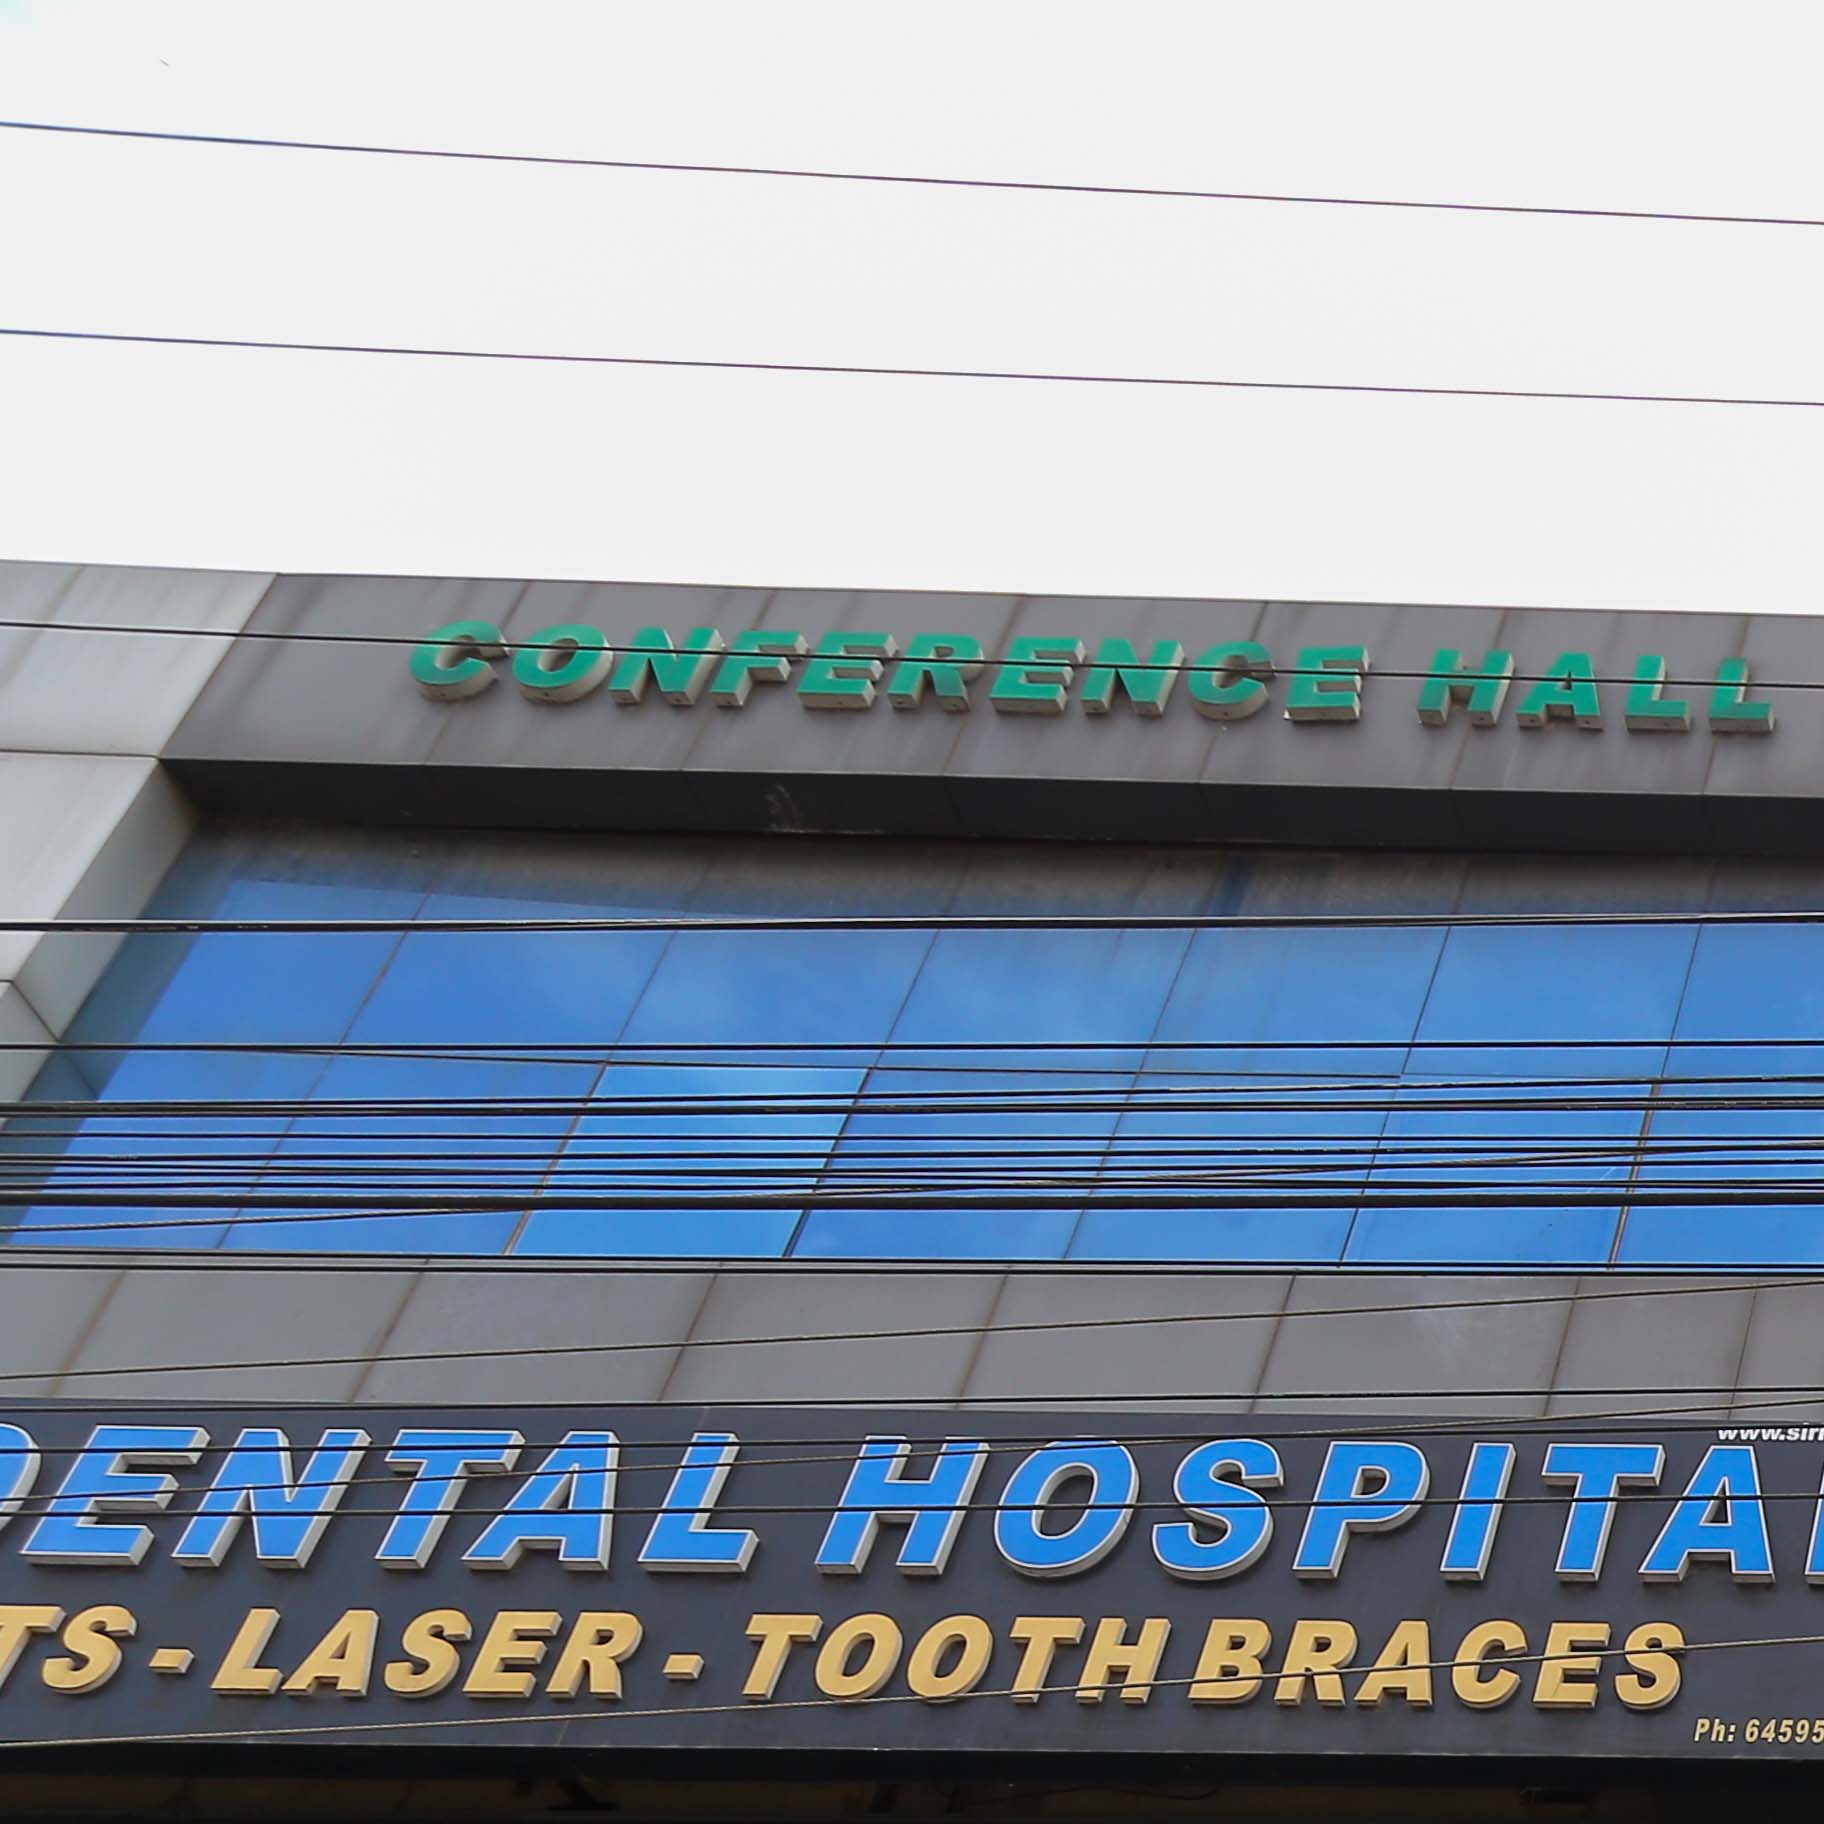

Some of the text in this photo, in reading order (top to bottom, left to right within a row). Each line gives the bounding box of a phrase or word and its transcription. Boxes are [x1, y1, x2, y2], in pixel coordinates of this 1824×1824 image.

[408, 620, 1776, 735] CONFERENCE HALL
[209, 1604, 644, 1700] LASER
[740, 1612, 1171, 1706] TOOTH
[1187, 1617, 1688, 1712] BRACES
[1693, 1717, 1736, 1743] Ph:
